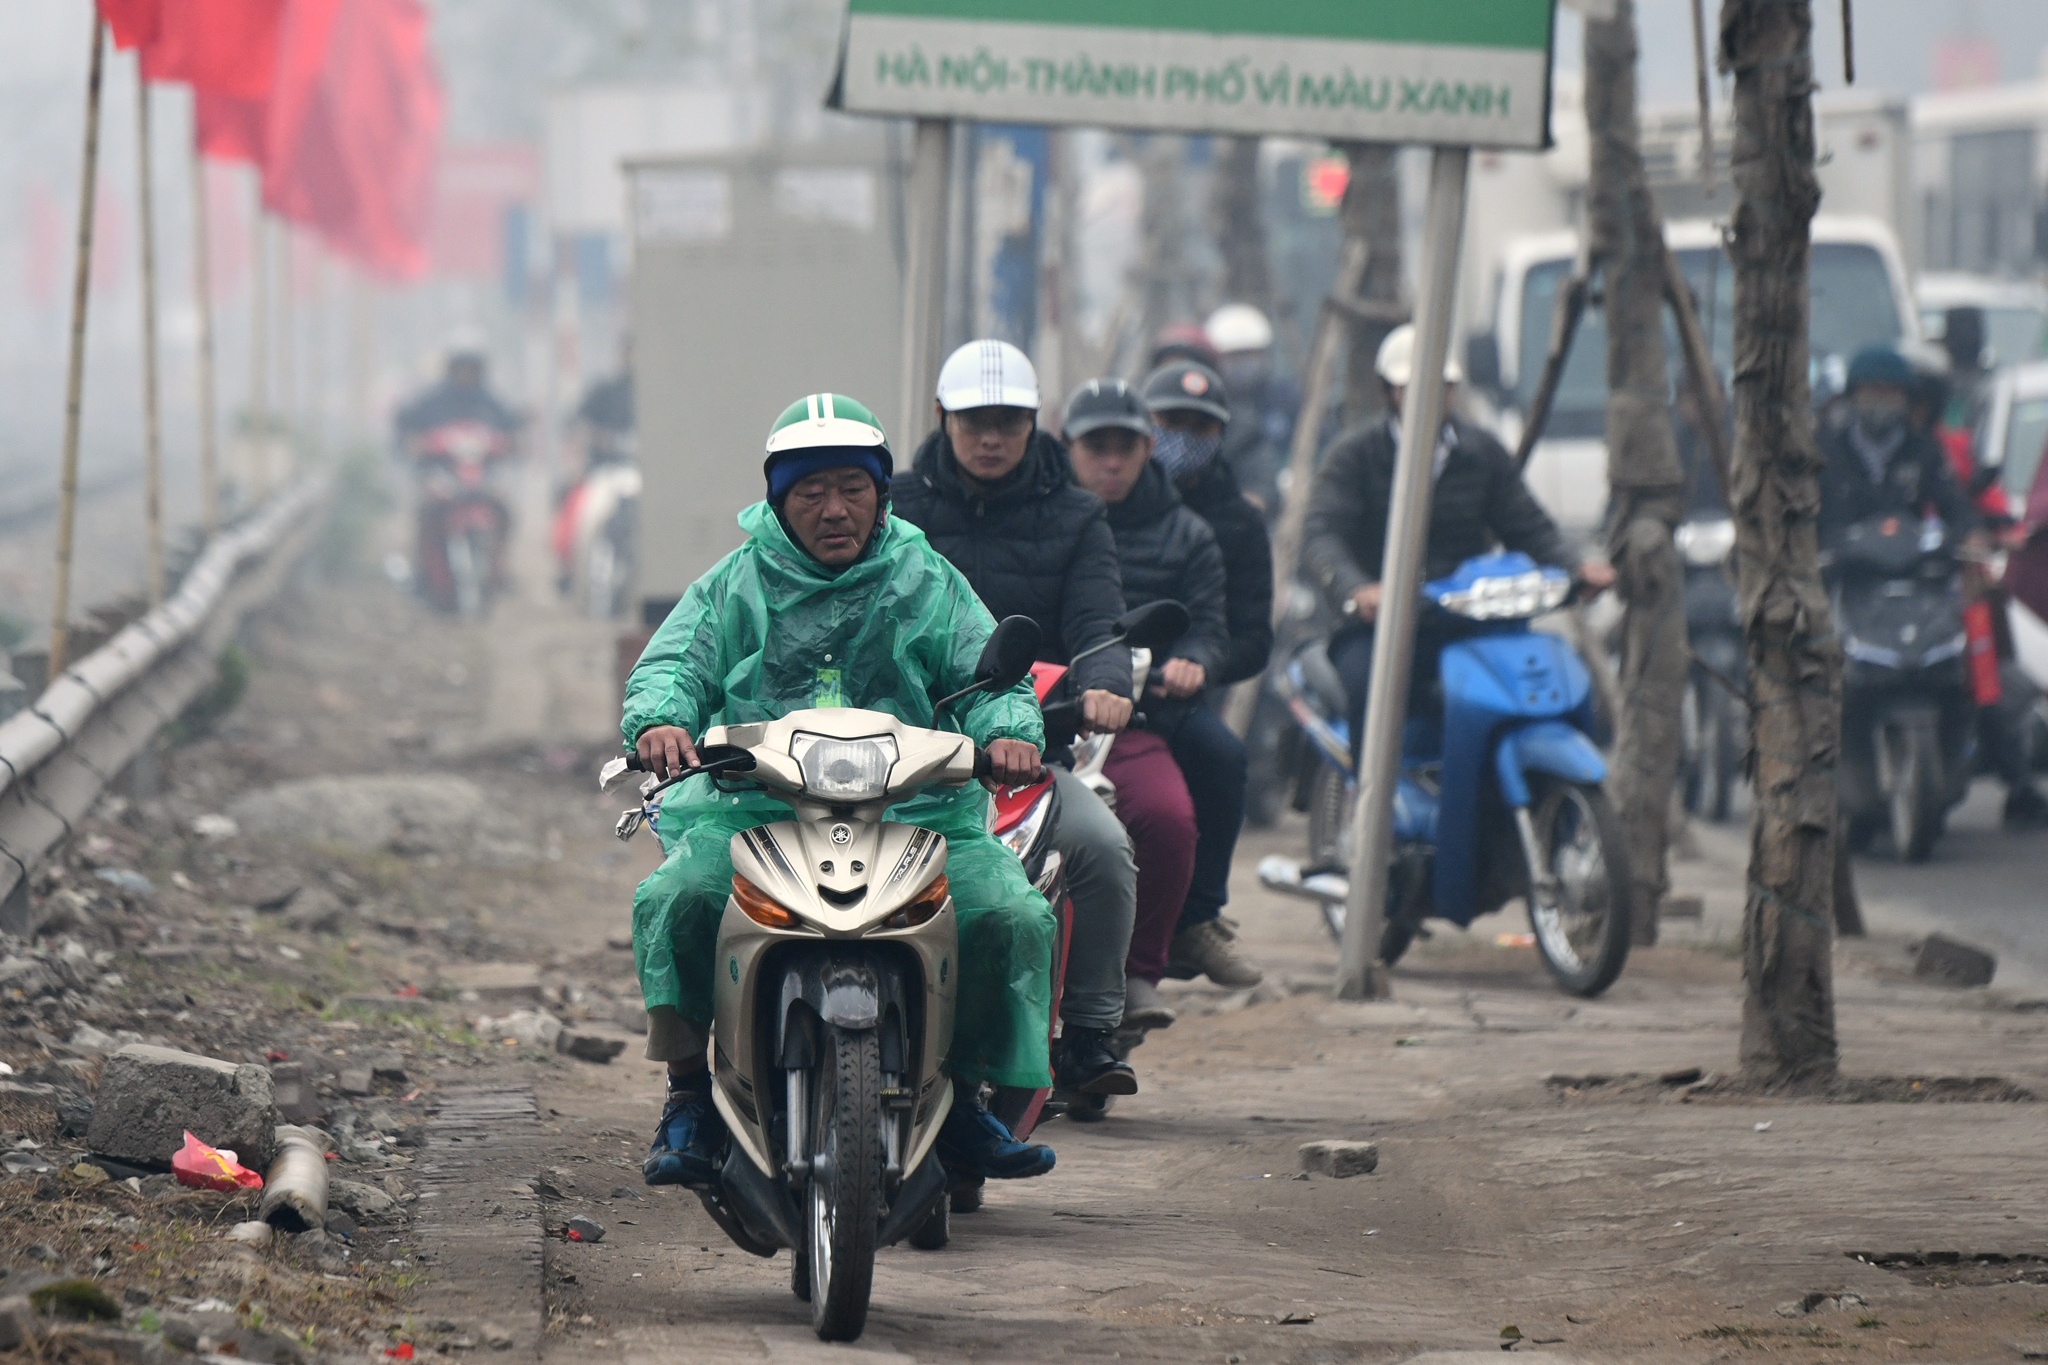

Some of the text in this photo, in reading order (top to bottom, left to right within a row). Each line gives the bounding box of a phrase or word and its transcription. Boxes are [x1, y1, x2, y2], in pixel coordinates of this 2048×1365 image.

[877, 43, 931, 88] HÀ
[1164, 55, 1250, 106] PHỐ
[1298, 65, 1392, 113] MÀU
[1398, 77, 1512, 118] XANH
[893, 846, 918, 882] TAURUS
